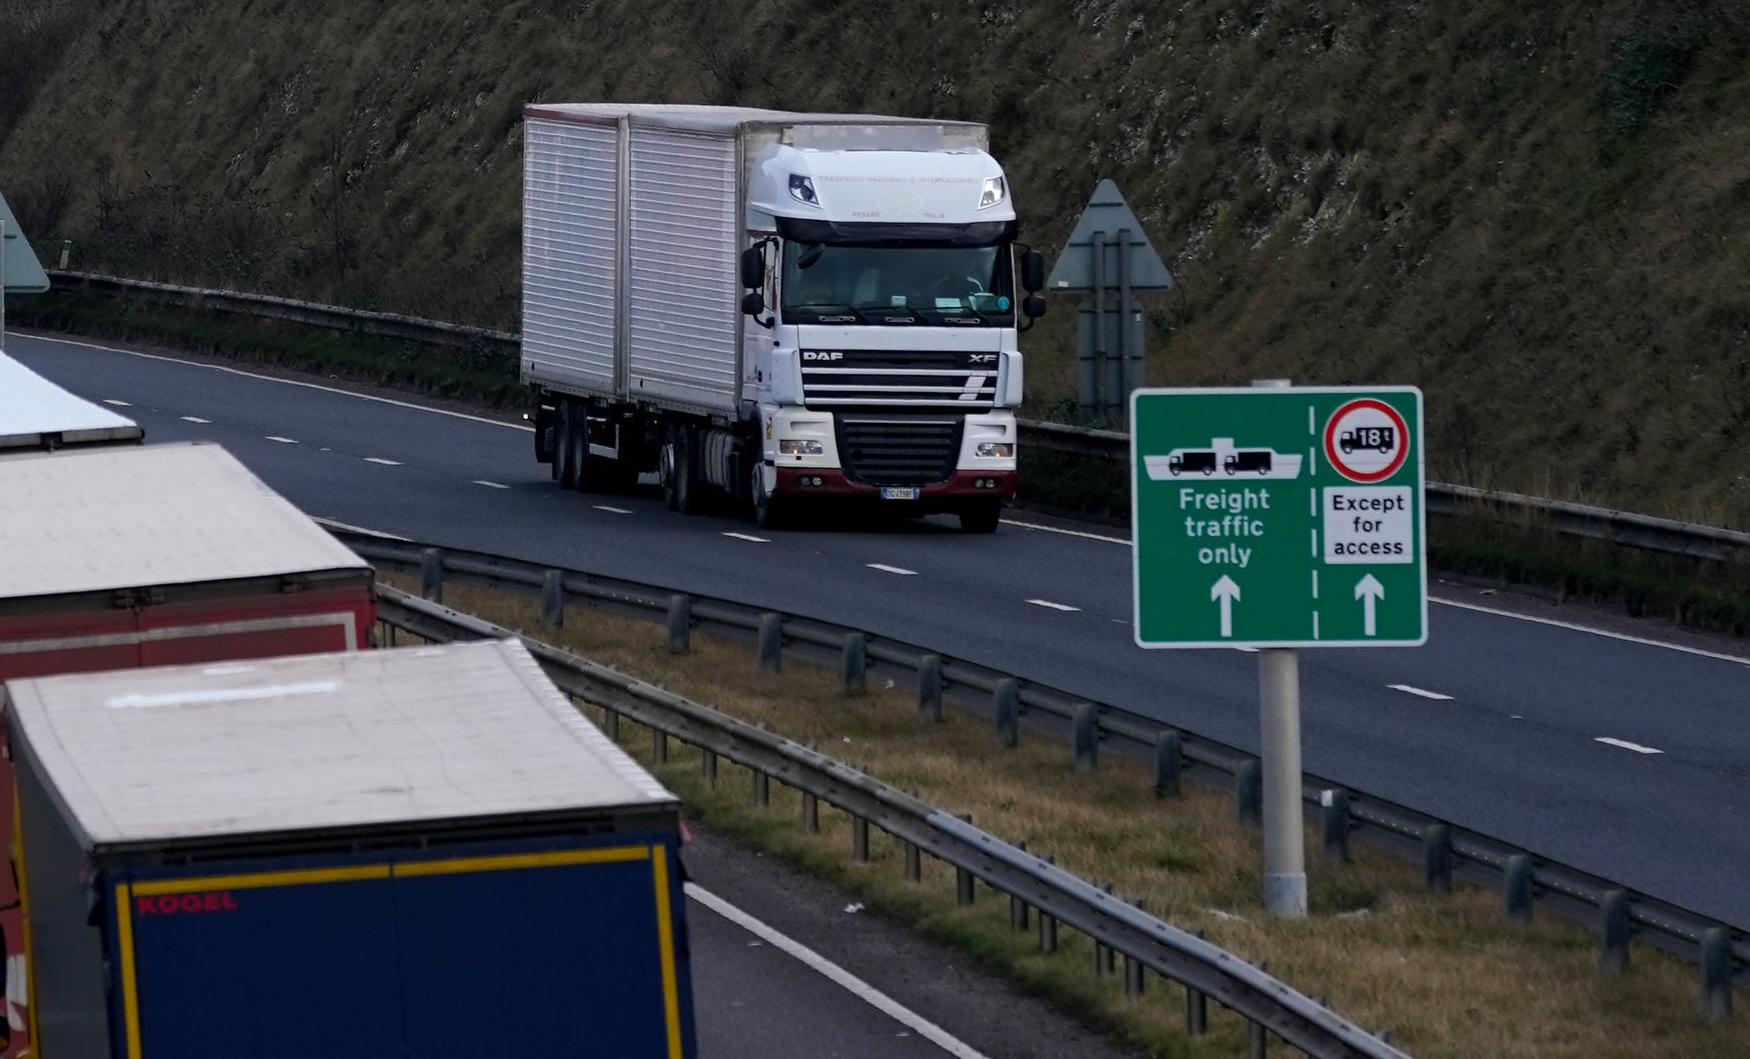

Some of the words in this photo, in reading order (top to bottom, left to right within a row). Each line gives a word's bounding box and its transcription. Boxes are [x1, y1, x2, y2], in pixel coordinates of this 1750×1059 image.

[803, 351, 844, 361] DAF
[968, 353, 999, 363] XF
[1179, 487, 1270, 513] Freight
[1332, 494, 1405, 515] Except
[1184, 516, 1264, 537] traffic
[1353, 516, 1383, 533] for
[1198, 543, 1252, 568] only
[1334, 539, 1404, 555] access
